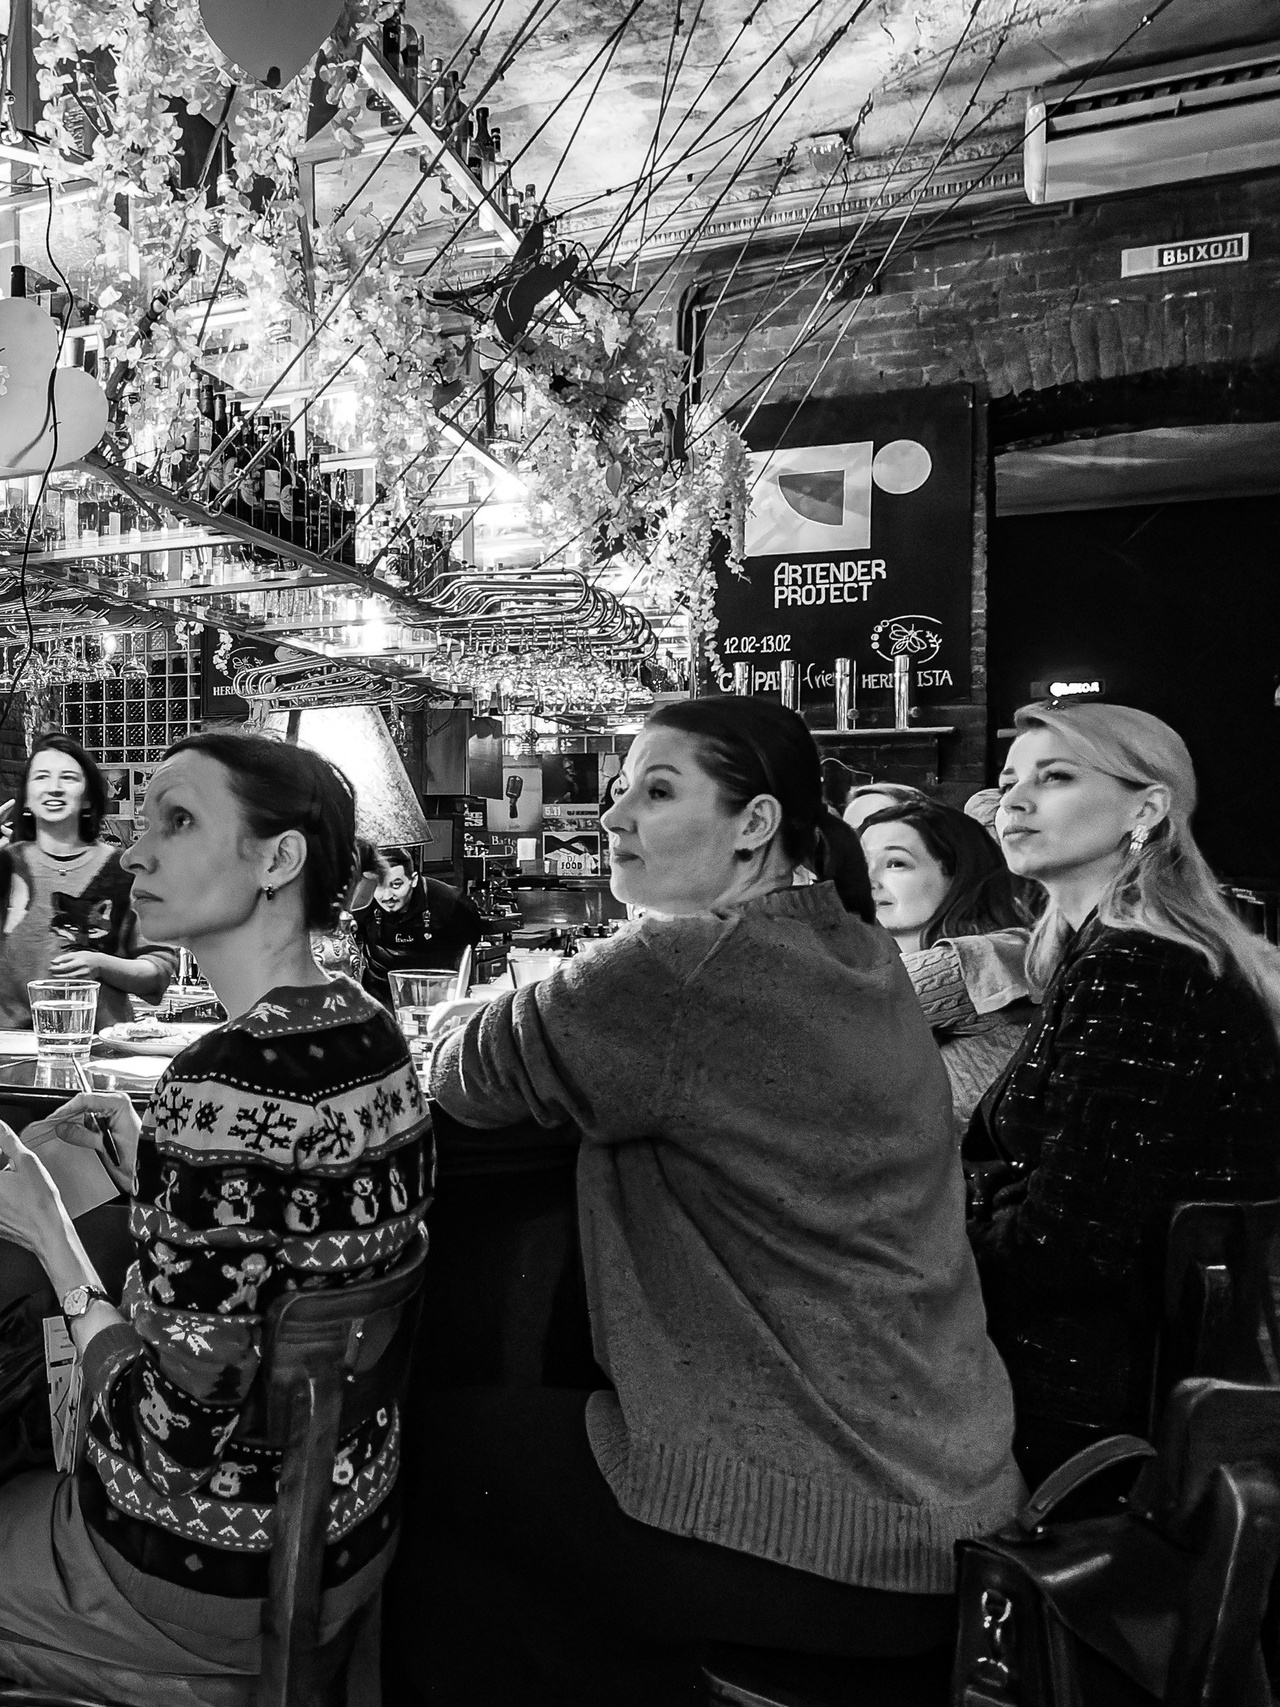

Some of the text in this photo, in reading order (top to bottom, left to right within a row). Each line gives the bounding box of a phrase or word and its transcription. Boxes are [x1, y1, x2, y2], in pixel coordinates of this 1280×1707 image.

[1162, 240, 1240, 266] ВЫХОД
[773, 559, 887, 586] ARTENDER
[773, 582, 873, 609] PROJECT
[723, 634, 791, 654] 12.02-13.02
[861, 669, 953, 689] HERISTA
